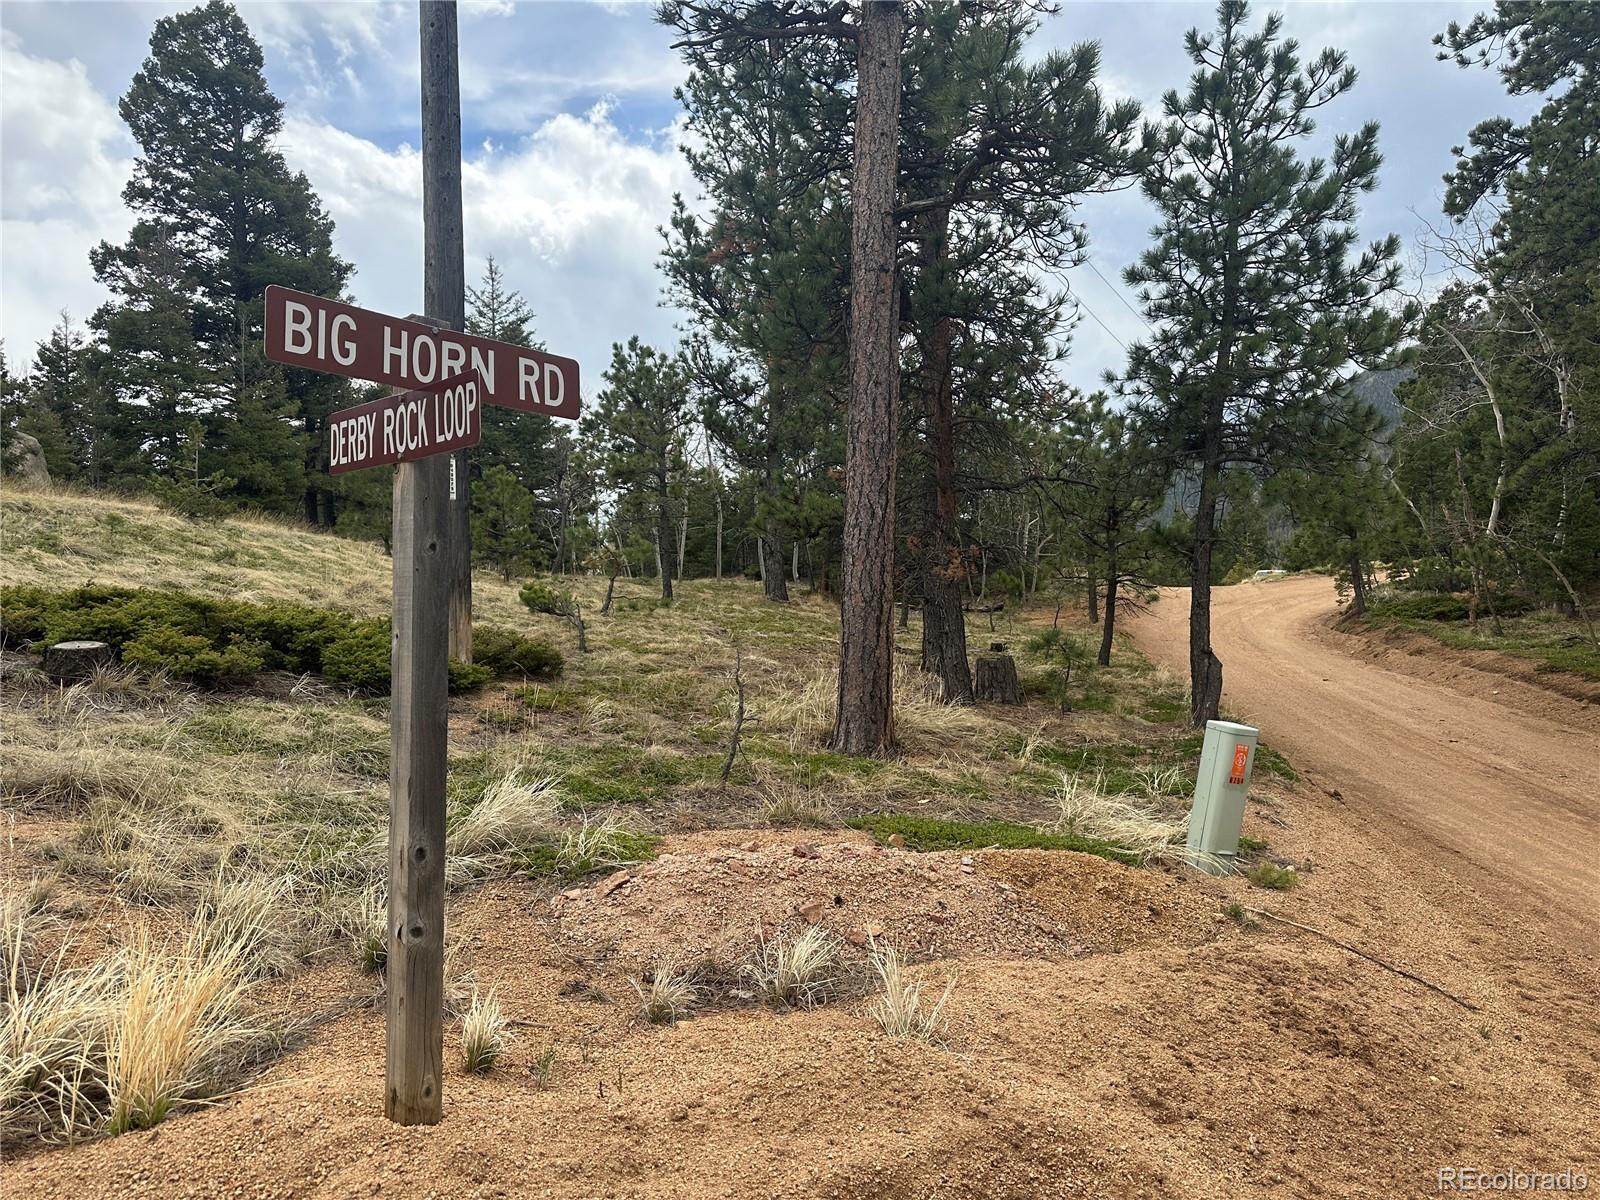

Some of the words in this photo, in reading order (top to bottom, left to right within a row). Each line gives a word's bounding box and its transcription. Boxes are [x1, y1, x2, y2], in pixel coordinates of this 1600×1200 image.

[284, 300, 357, 366] BIG
[383, 326, 495, 395] HORN
[518, 357, 565, 407] RD
[330, 411, 377, 467] DERBY
[383, 398, 429, 455] ROCK
[435, 381, 477, 444] LOOP
